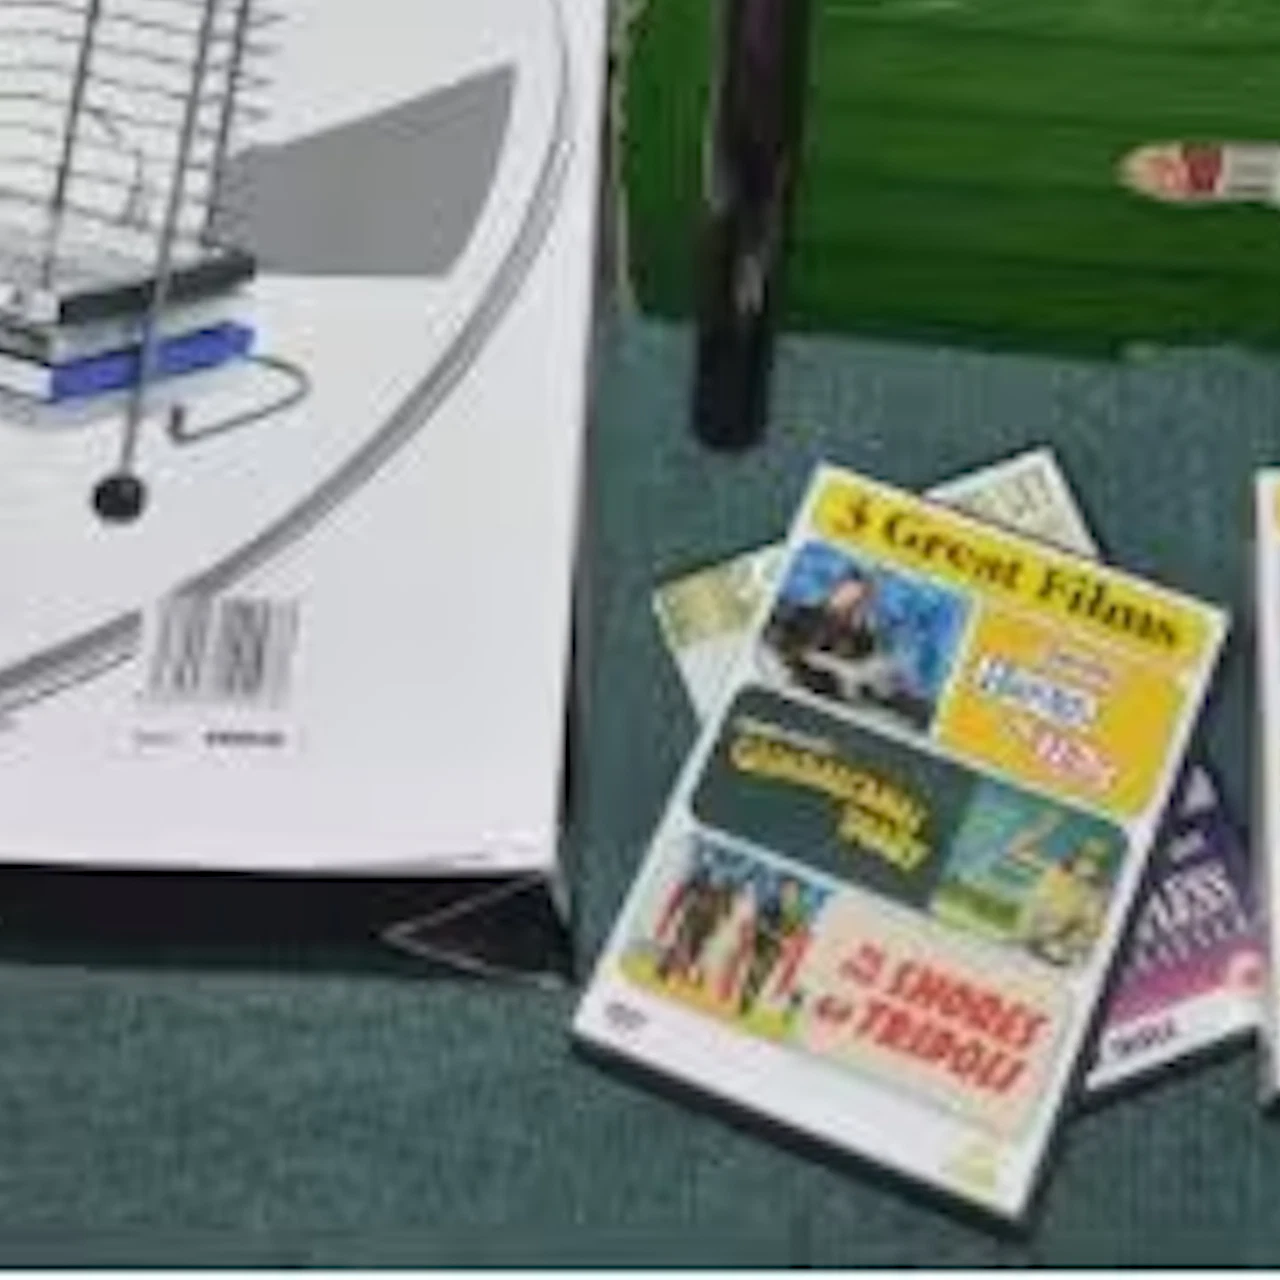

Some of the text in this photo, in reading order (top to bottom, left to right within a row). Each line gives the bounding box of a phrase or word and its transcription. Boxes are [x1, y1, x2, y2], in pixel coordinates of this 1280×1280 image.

[840, 496, 1180, 648] 3 Great Films
[854, 1002, 1030, 1096] TRIPOLI
[890, 954, 1053, 1050] SHORES
